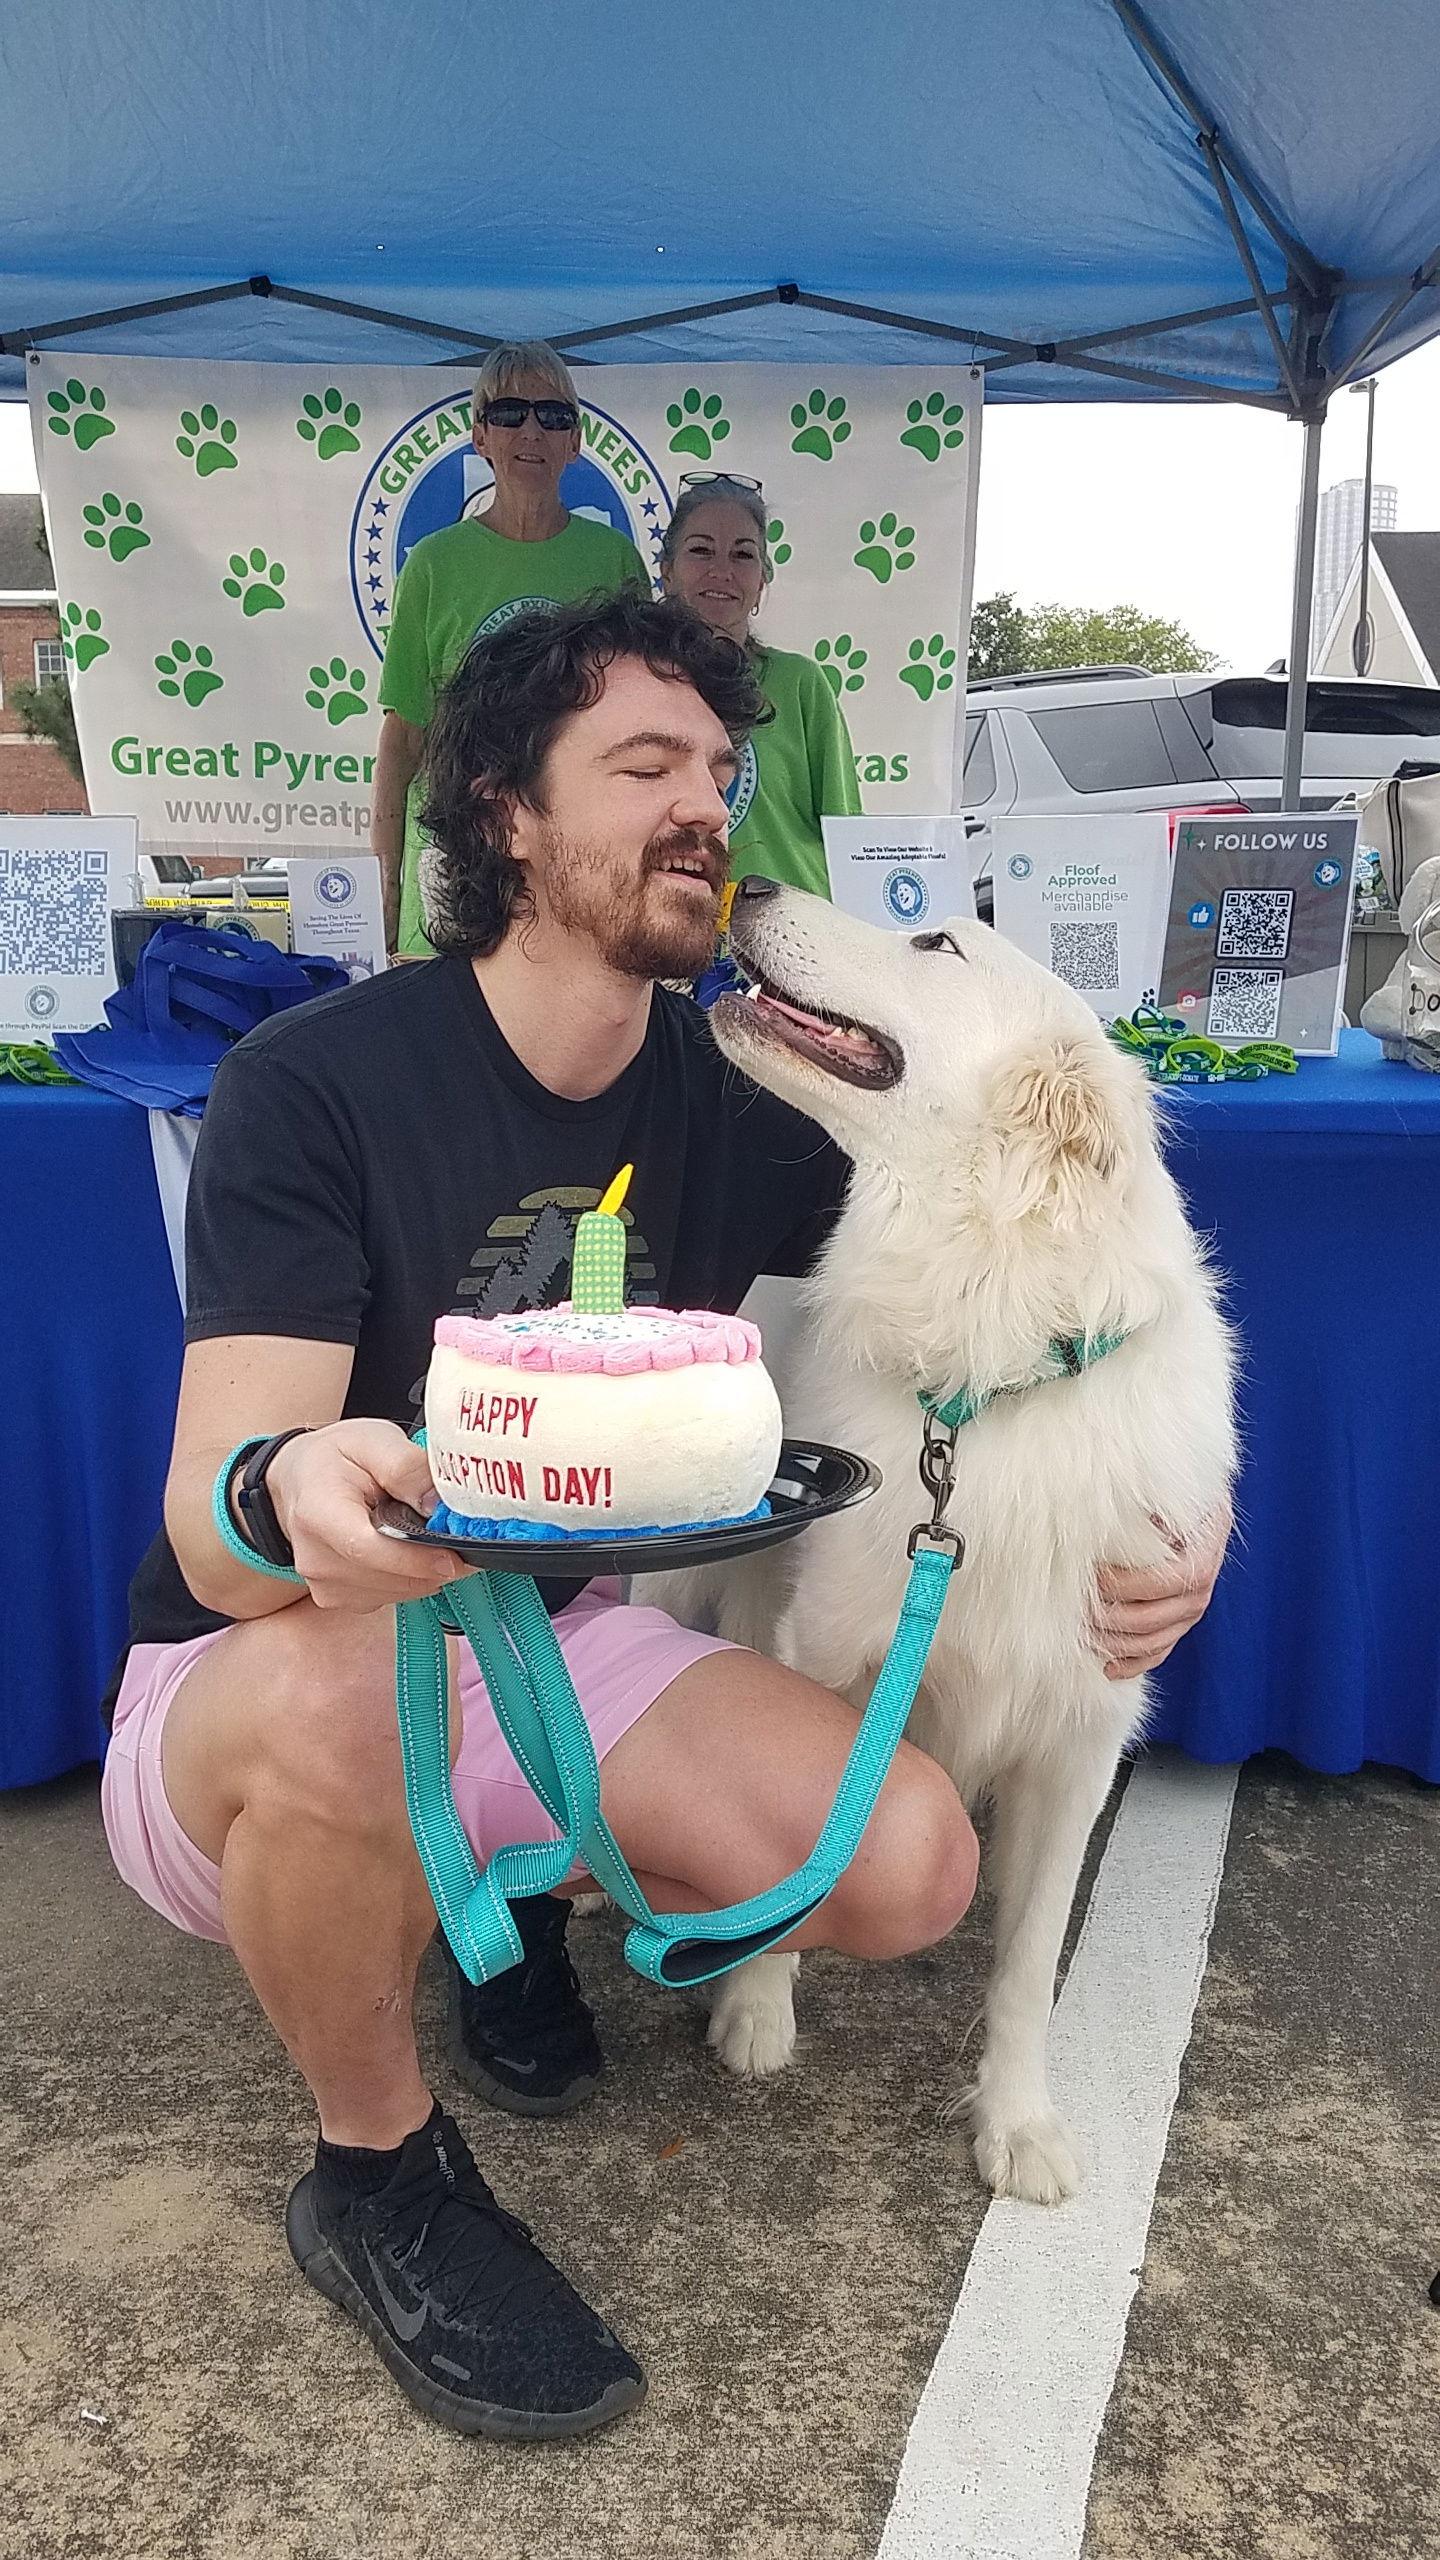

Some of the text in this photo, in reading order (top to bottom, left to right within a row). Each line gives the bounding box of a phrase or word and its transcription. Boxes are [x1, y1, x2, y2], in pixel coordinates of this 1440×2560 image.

[379, 402, 651, 495] GREAT NEES
[483, 604, 516, 633] REAT
[111, 737, 240, 777] Great
[254, 741, 377, 791] Pyre
[165, 800, 371, 836] www.greatp
[728, 795, 748, 830] EXAS
[1214, 832, 1328, 851] FOLLOW US
[1048, 874, 1117, 888] Approved
[1065, 864, 1101, 876] Floof
[1041, 890, 1129, 902] Merchandise
[1054, 900, 1113, 912] available
[459, 1390, 539, 1438] HAPPY
[542, 1466, 612, 1508] DAY!
